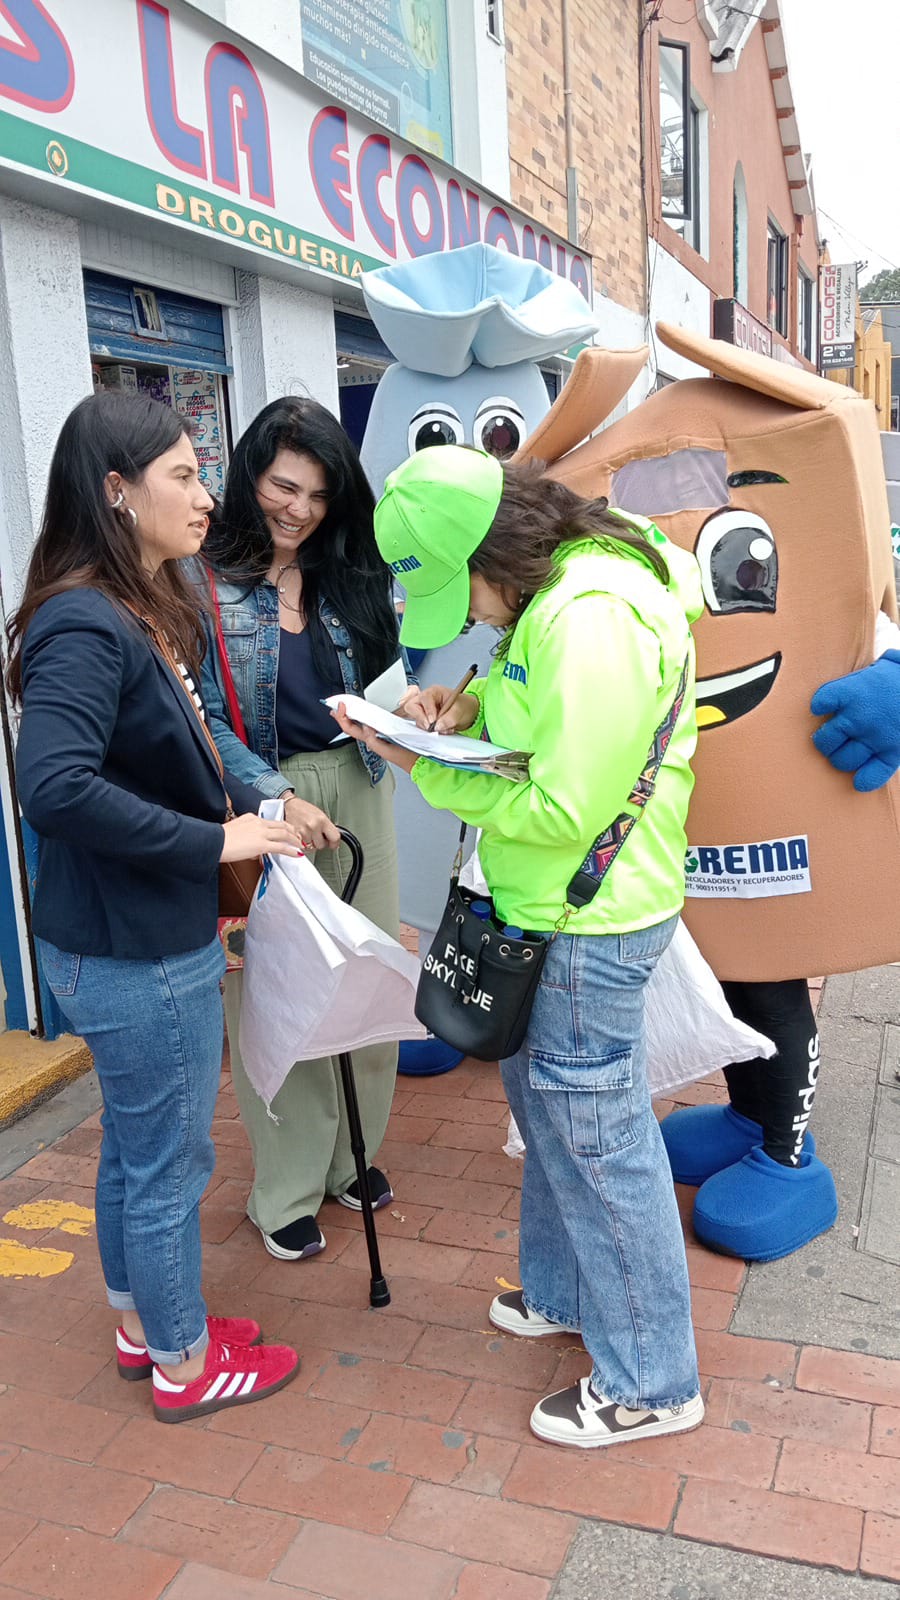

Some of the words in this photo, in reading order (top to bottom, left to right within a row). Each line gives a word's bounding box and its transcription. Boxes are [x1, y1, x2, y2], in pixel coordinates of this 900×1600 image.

[303, 5, 333, 33] muchos
[137, 0, 275, 208] LA
[156, 183, 366, 278] DROGUERIA
[823, 346, 834, 357] 2
[743, 873, 804, 885] RECUPERADORES
